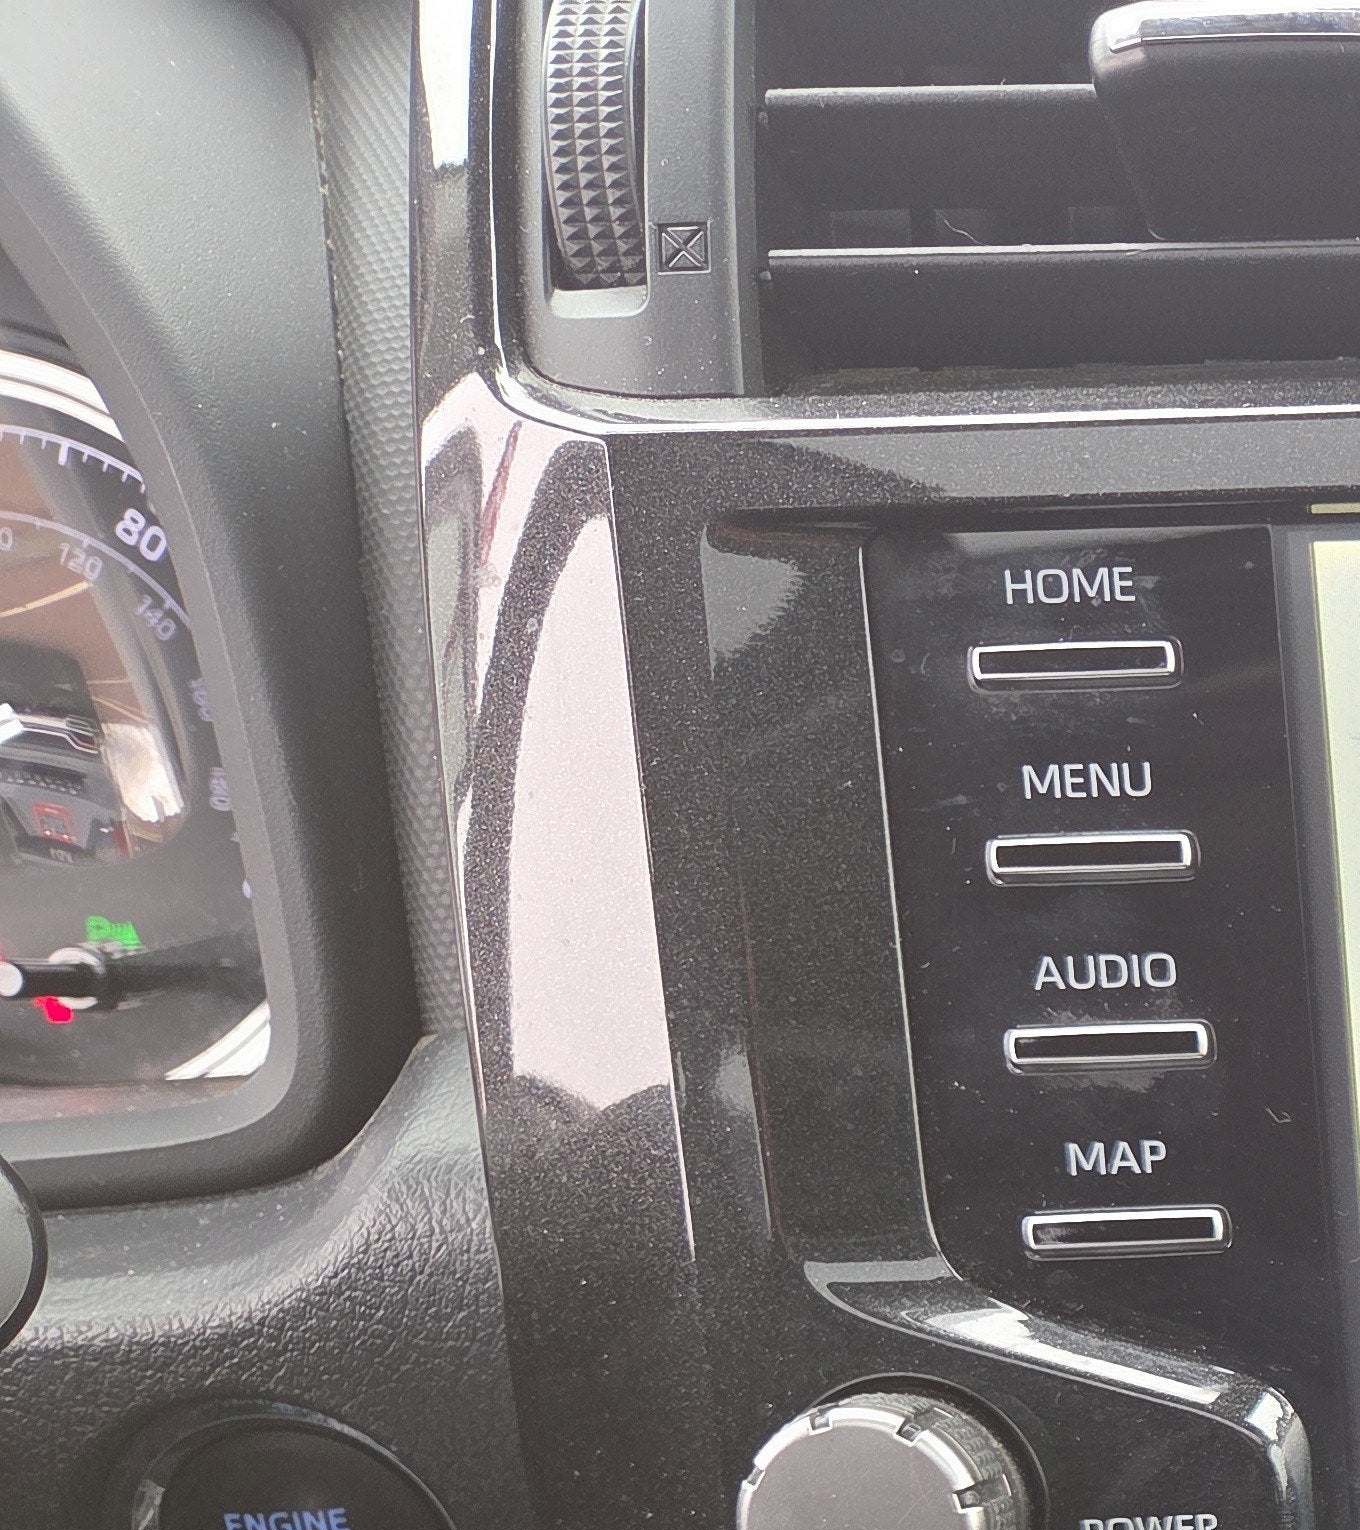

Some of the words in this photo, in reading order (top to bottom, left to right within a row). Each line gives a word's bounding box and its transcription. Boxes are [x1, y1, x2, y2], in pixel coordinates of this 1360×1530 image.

[115, 508, 168, 562] 80
[59, 542, 102, 581] 120
[1004, 566, 1136, 605] HOME
[135, 594, 176, 641] 140
[1021, 761, 1152, 800] MENU
[1034, 952, 1177, 991] AUDIO
[1064, 1139, 1167, 1177] MAP
